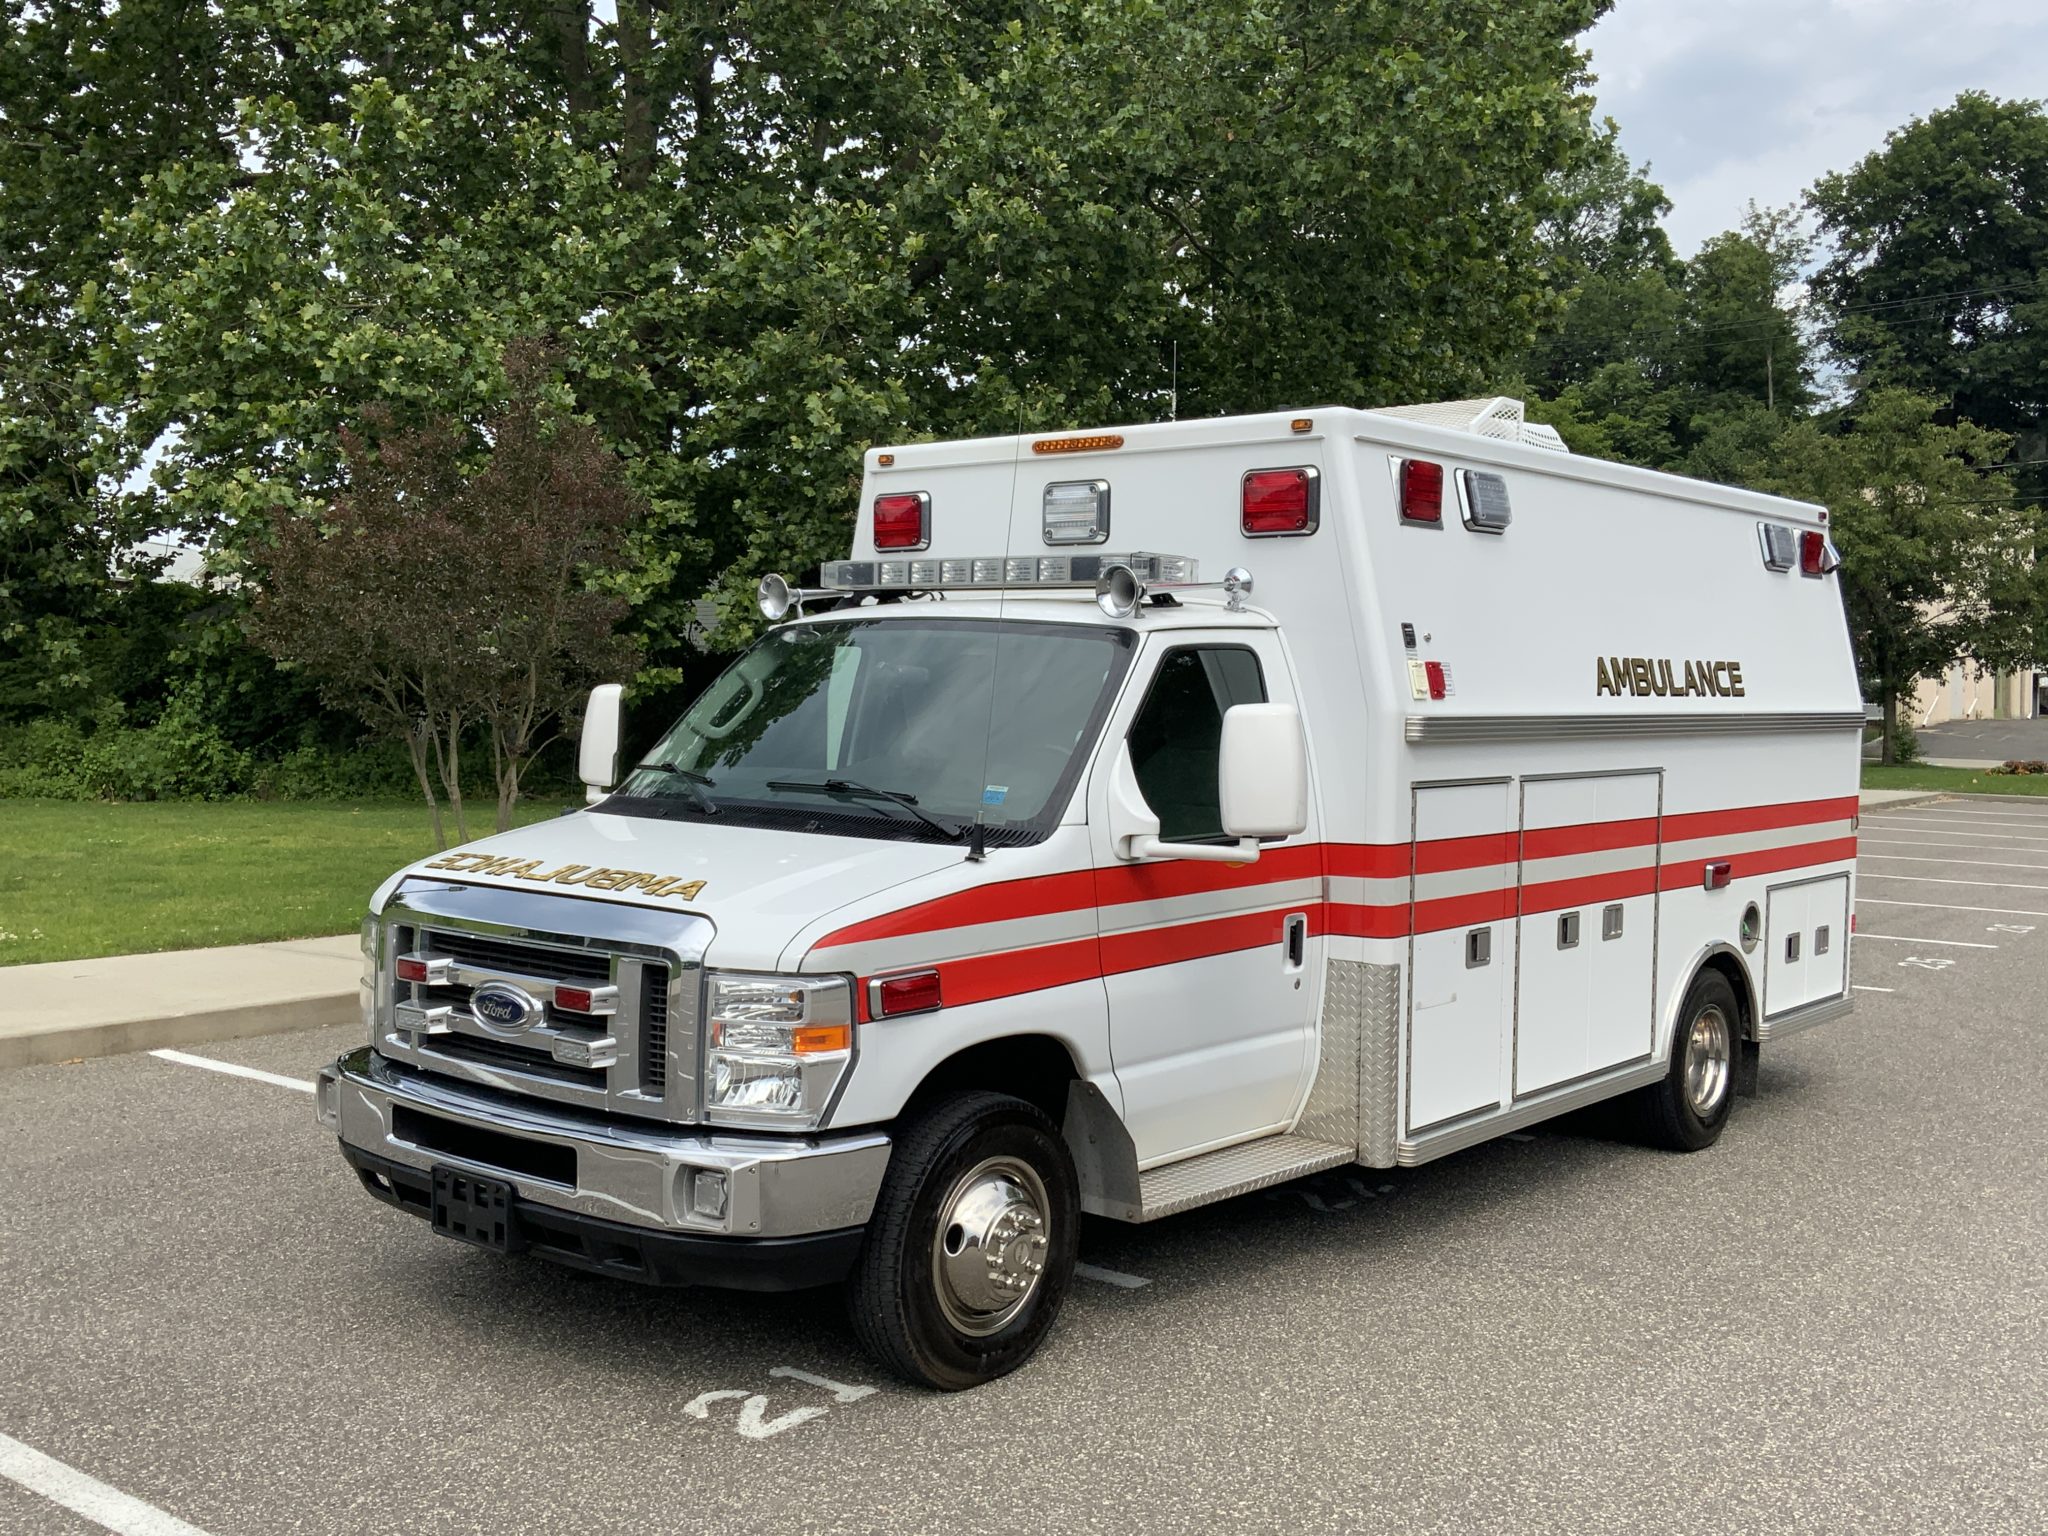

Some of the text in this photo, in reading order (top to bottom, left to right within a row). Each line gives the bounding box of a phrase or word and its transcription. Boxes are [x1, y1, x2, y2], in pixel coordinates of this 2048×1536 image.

[1597, 656, 1745, 697] AMBULANCE
[482, 995, 512, 1019] Ford
[682, 1365, 880, 1438] 21
